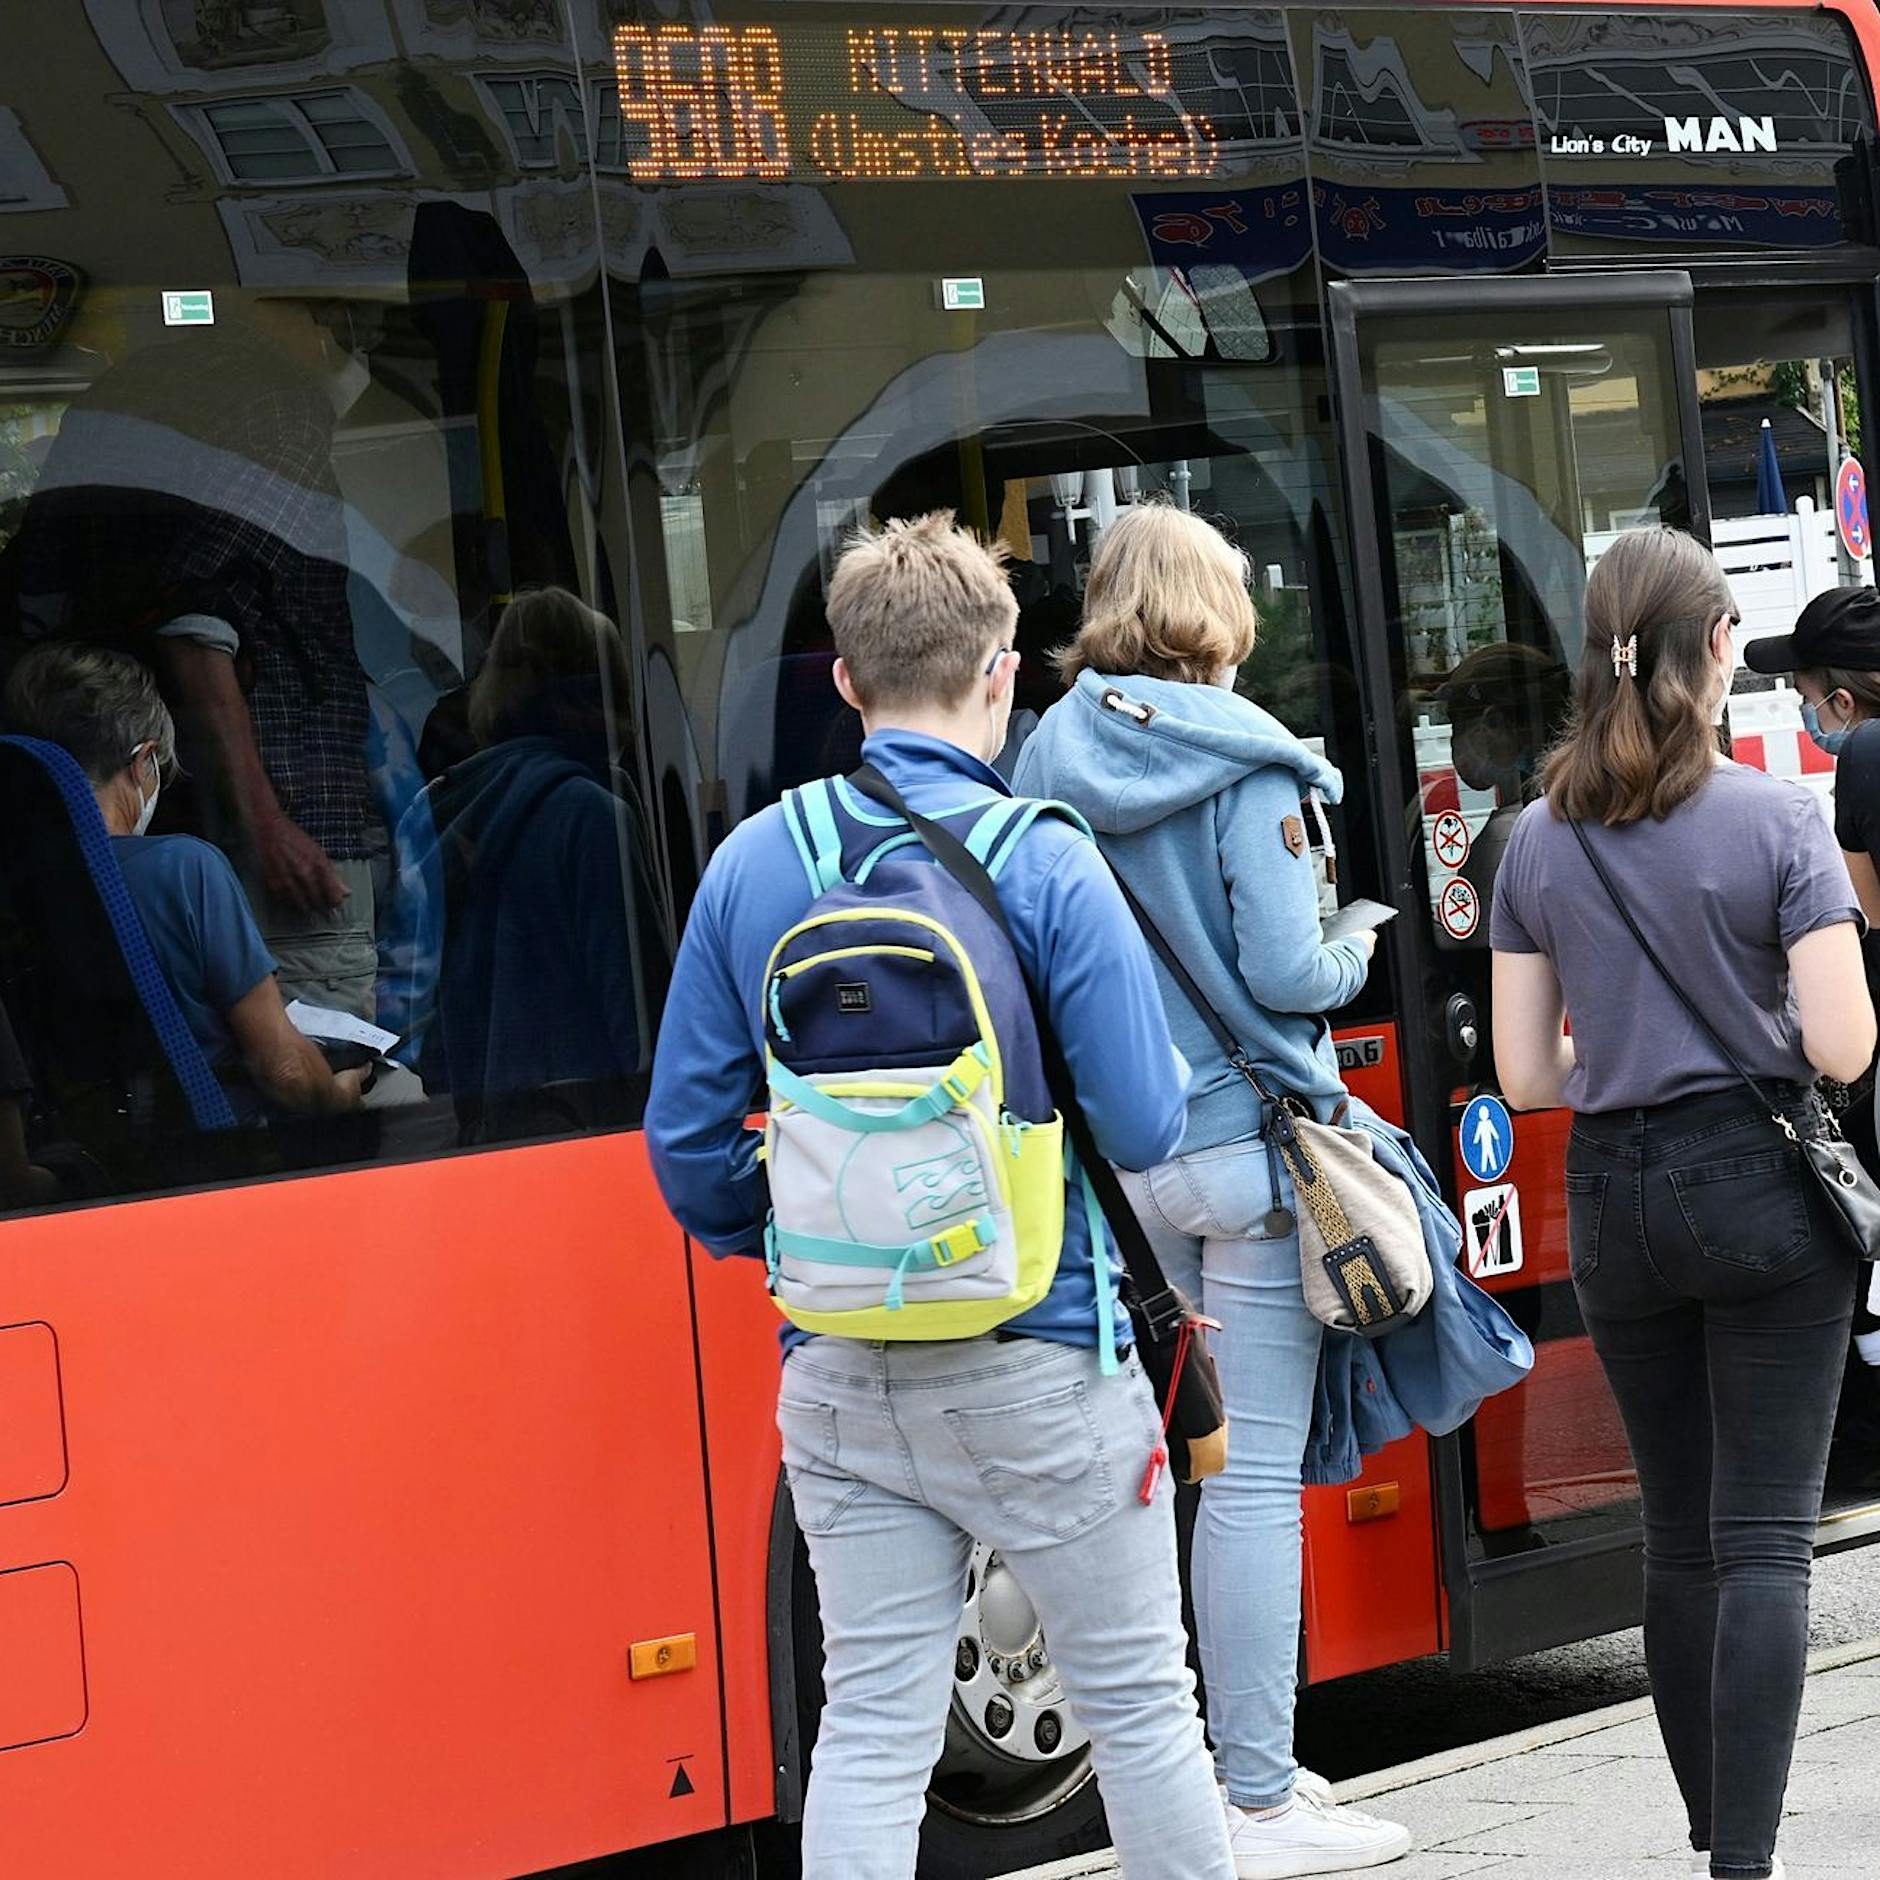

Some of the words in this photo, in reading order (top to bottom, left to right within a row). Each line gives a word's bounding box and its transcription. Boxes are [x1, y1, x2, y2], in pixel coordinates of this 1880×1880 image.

[846, 29, 1172, 94] MITTENWALD
[1551, 134, 1605, 153] Lion's
[1611, 134, 1653, 156] City
[1664, 116, 1778, 152] MAN
[1364, 1040, 1378, 1062] 6
